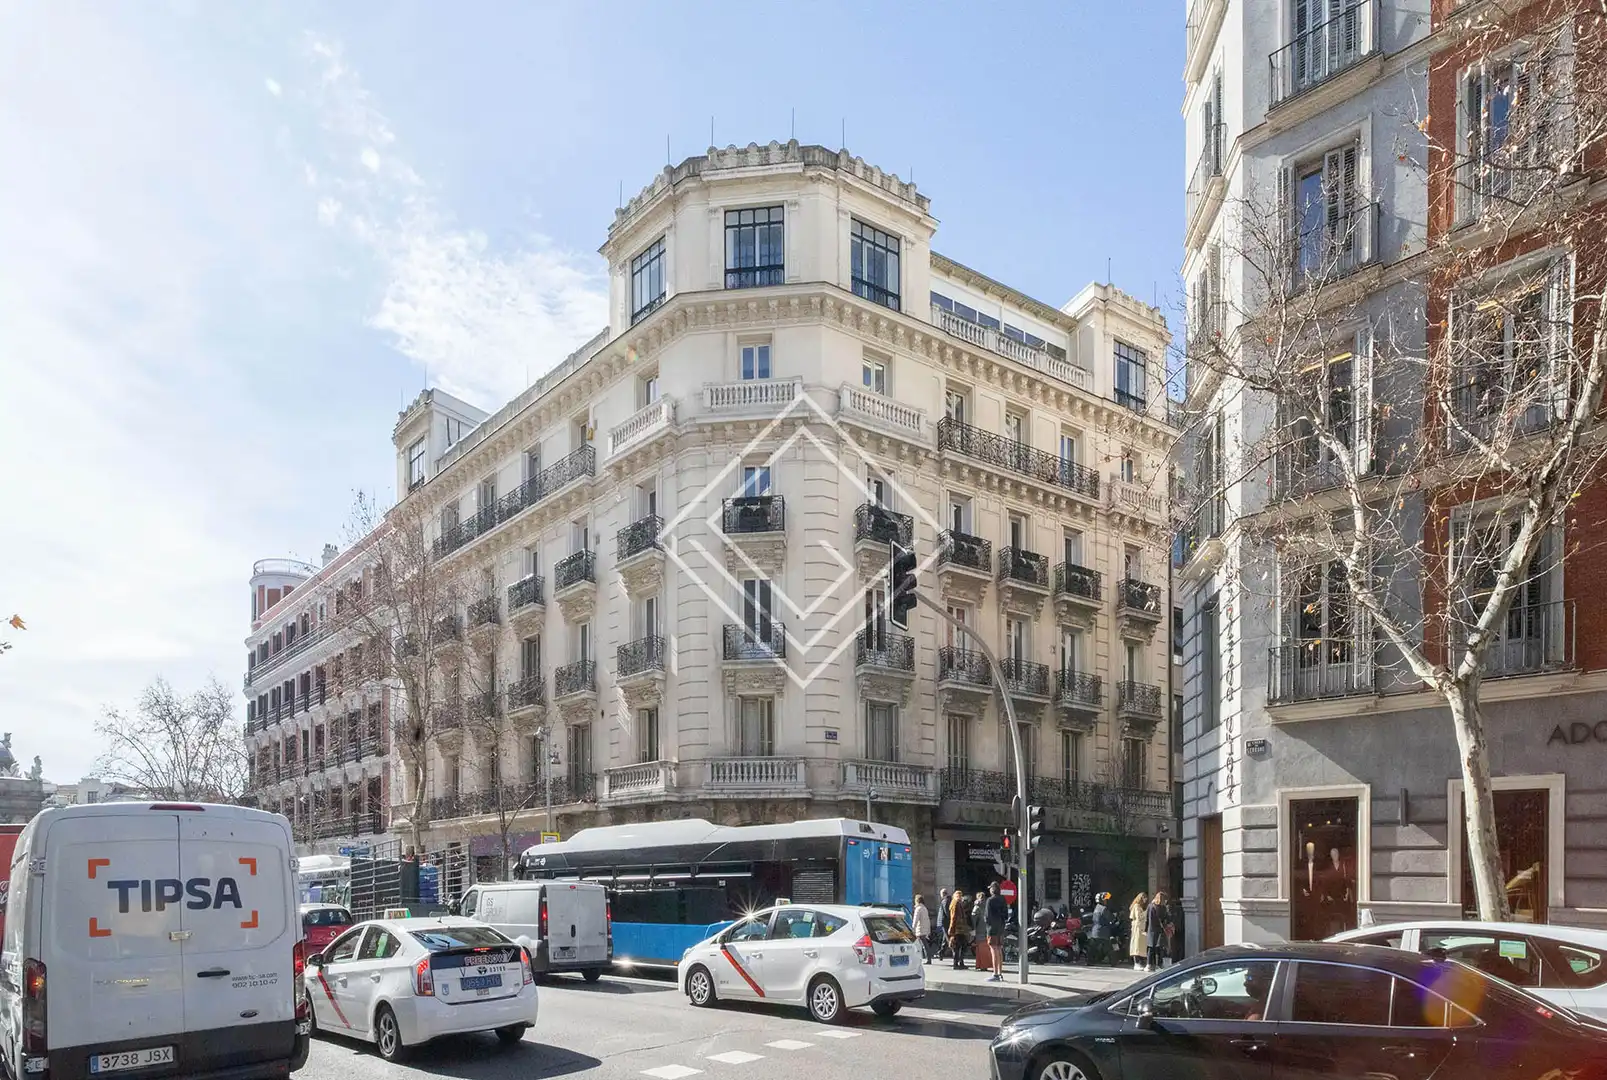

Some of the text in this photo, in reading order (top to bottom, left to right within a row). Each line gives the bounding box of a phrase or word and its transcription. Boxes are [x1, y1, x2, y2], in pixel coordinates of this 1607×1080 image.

[107, 877, 242, 913] TIPSA
[102, 1048, 170, 1069] 3738 JSX
